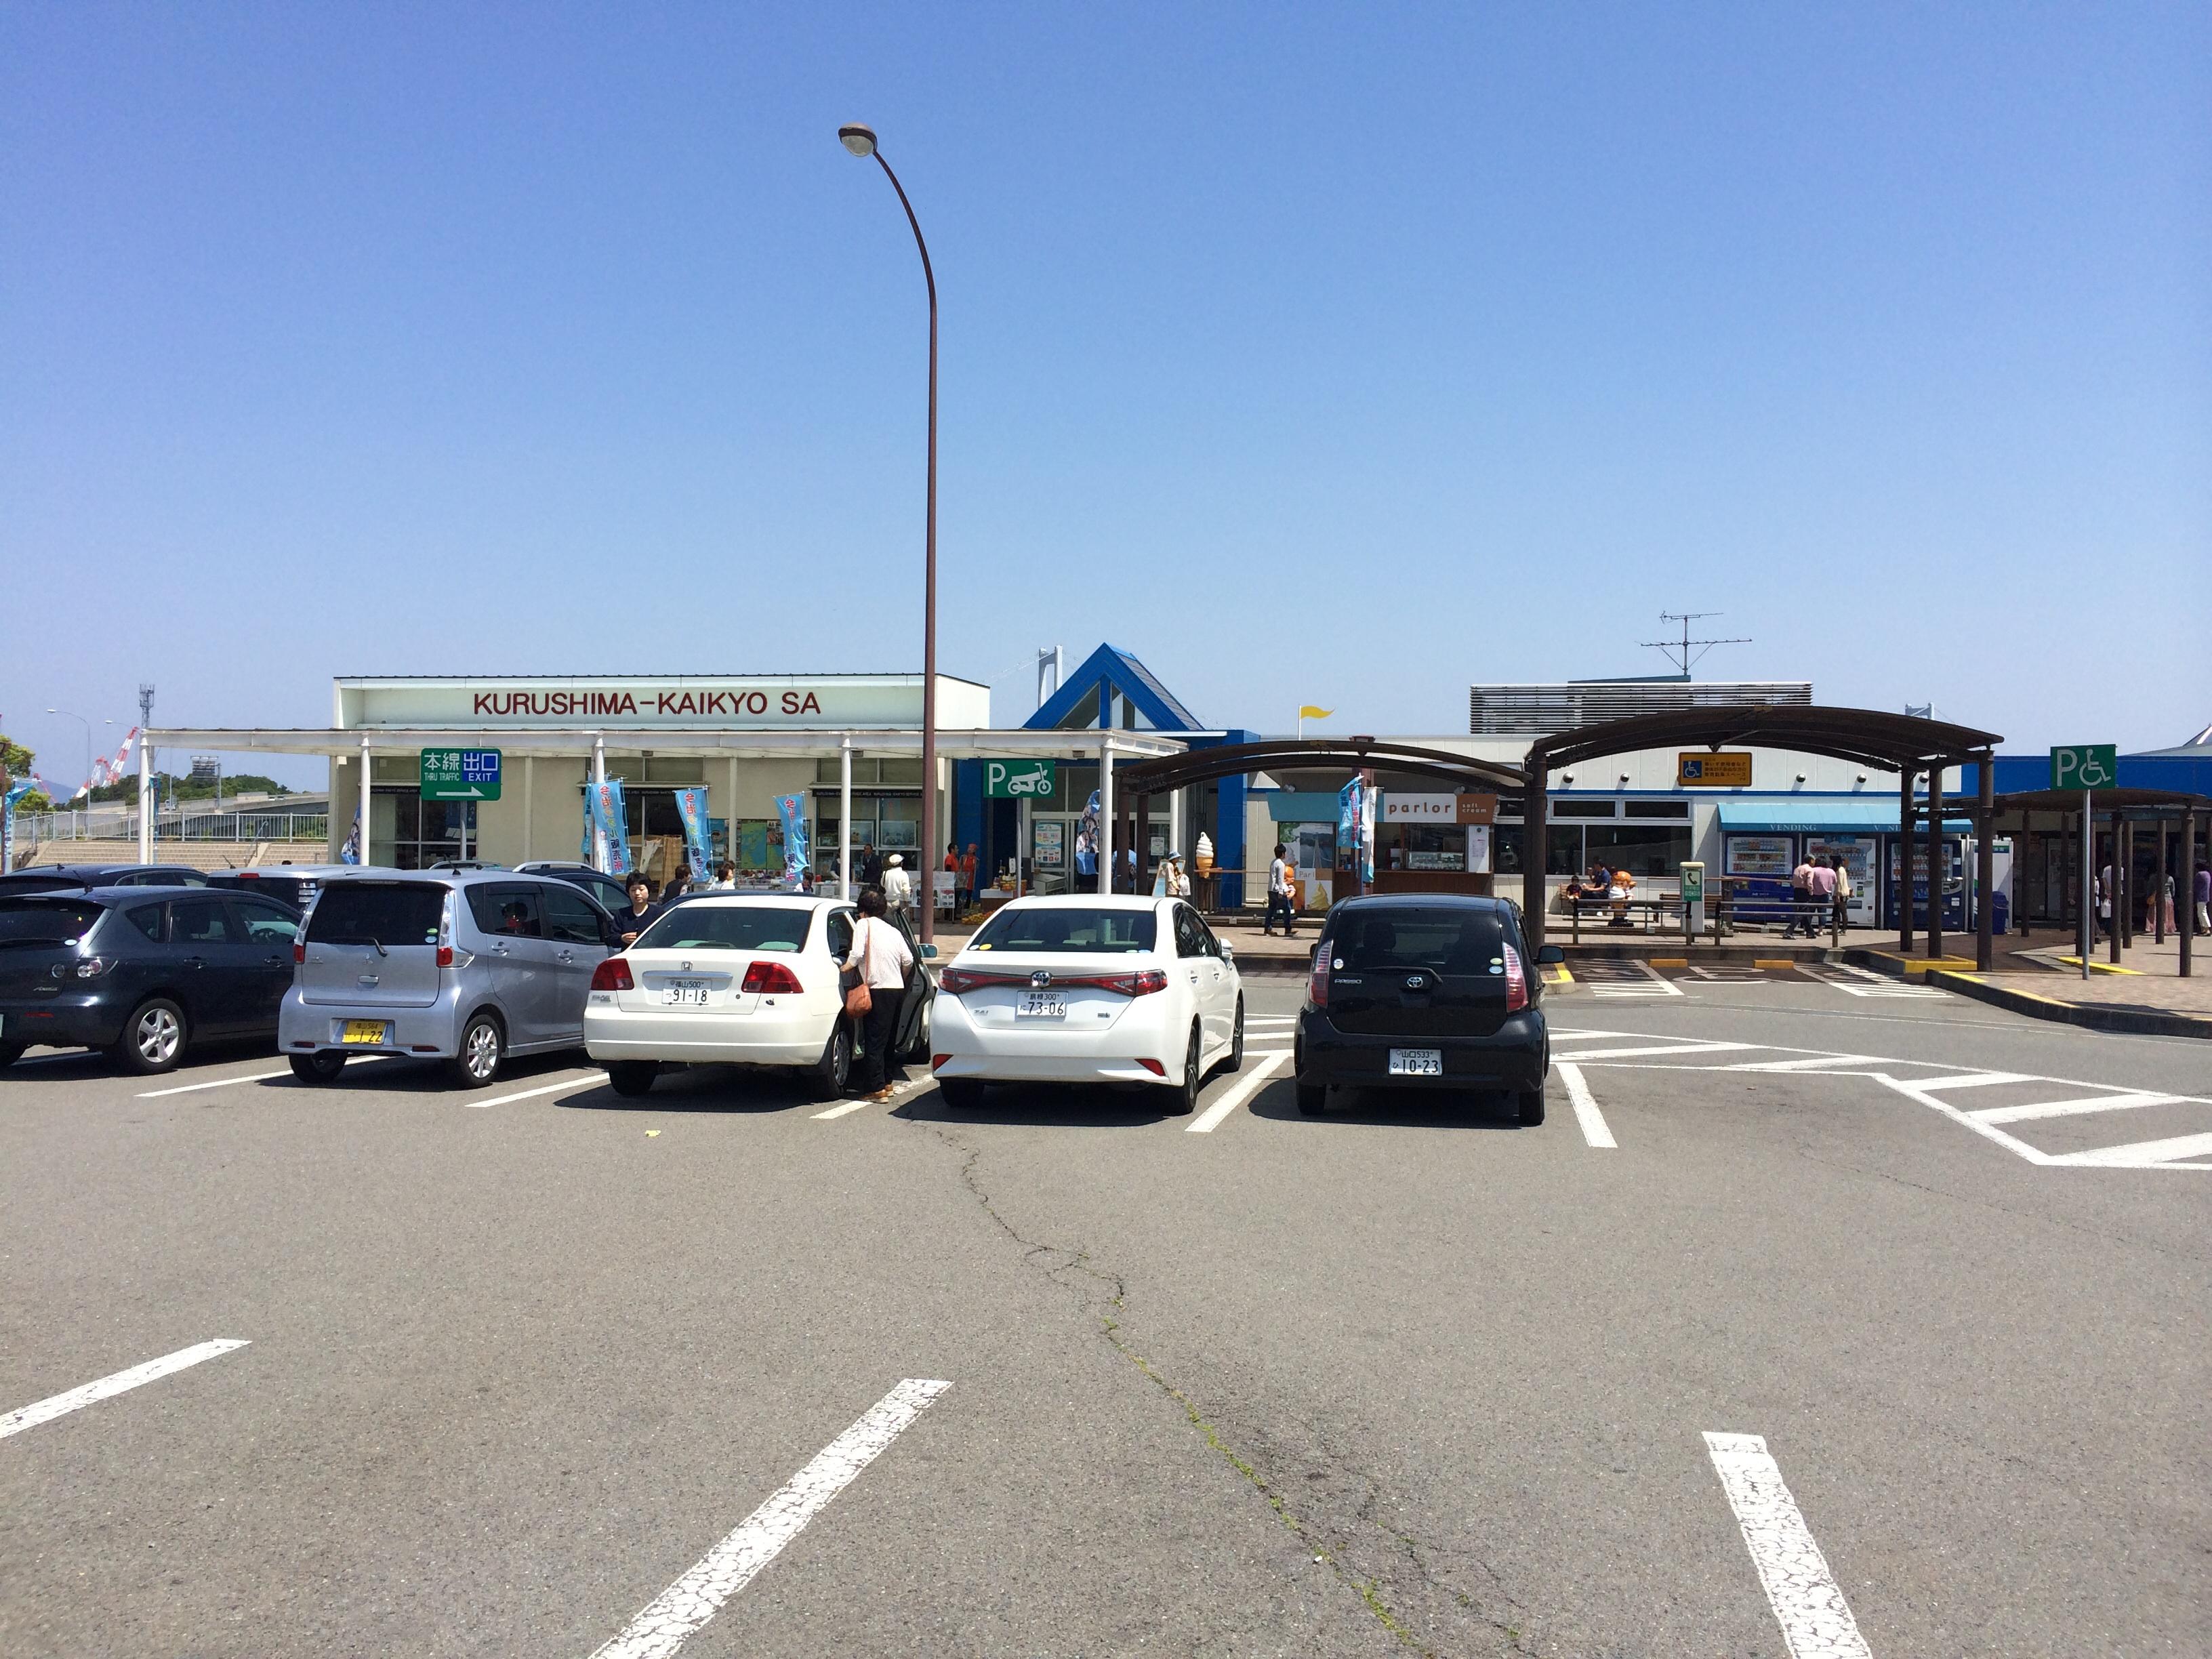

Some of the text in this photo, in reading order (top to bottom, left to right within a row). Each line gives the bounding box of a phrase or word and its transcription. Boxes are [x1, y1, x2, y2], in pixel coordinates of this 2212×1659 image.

[474, 692, 821, 716] KURUSHIMA-KAIKYO SA
[424, 752, 460, 771] 本線
[464, 752, 498, 771] 出口
[2057, 750, 2078, 787] P
[424, 773, 459, 781] THRU TRAFFIC
[468, 773, 492, 781] EXIT
[988, 763, 1006, 795] P
[1389, 802, 1451, 815] parlor
[673, 989, 708, 1002] 91-18
[1028, 1002, 1064, 1015] 73-06
[1401, 1050, 1430, 1059] 山口533
[1403, 1059, 1438, 1073] 10-23
